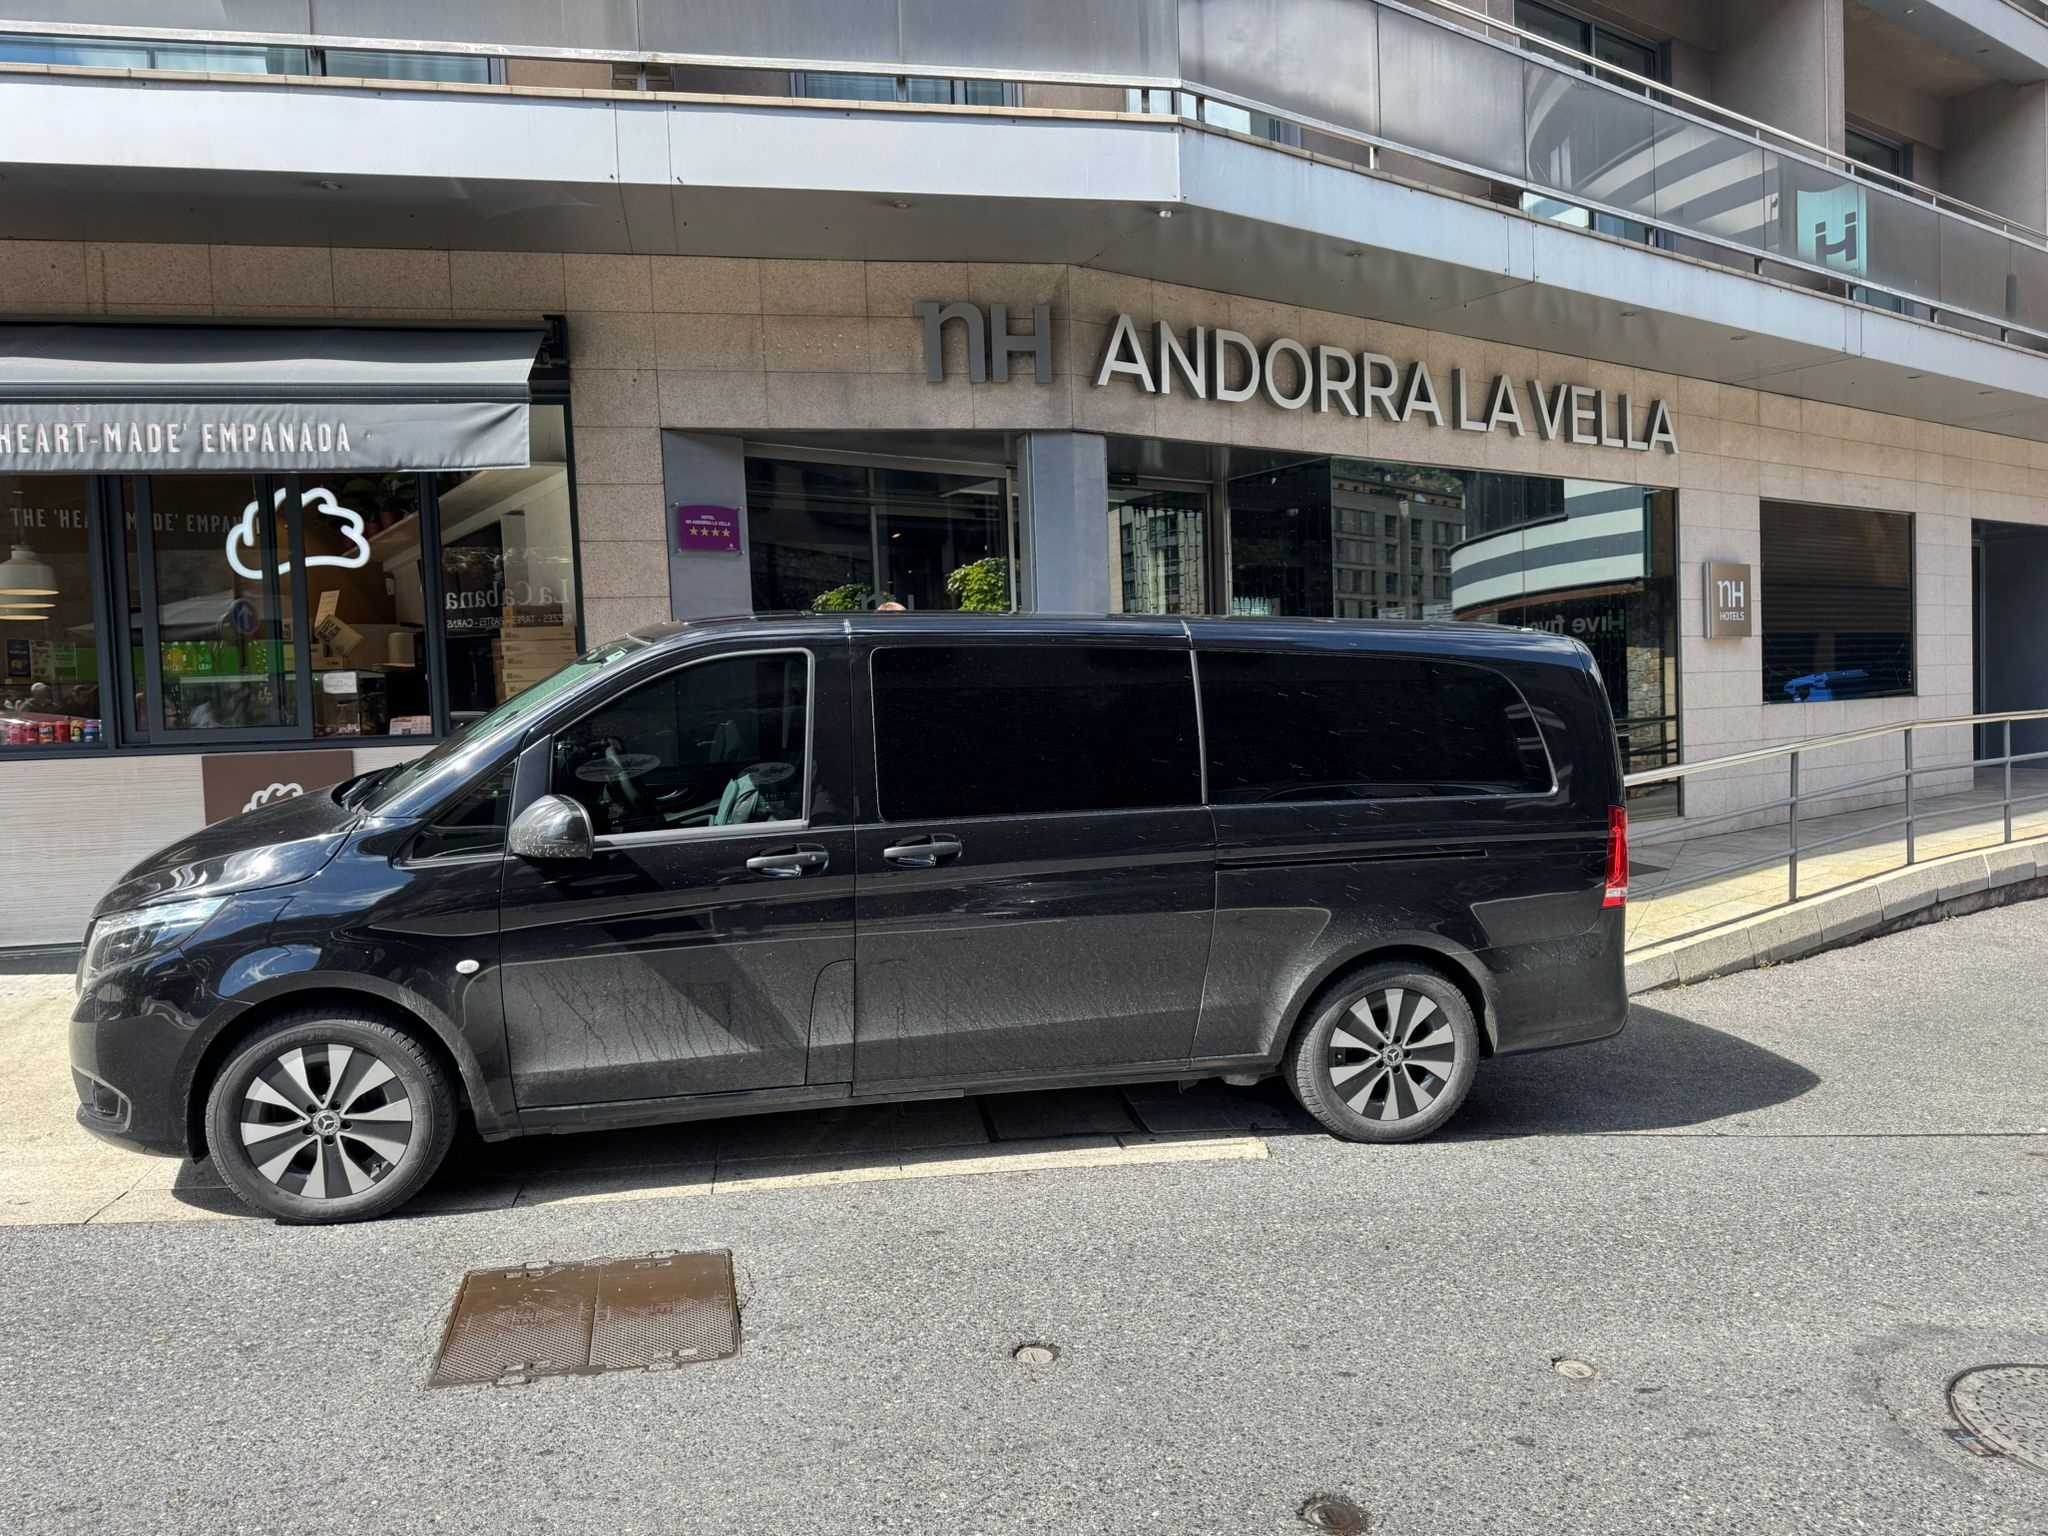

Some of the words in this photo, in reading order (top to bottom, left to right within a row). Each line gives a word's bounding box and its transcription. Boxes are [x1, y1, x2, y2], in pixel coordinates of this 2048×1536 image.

[1096, 314, 1444, 426] ANDORRA
[1452, 367, 1525, 436] LA
[1526, 379, 1679, 454] VELLA
[202, 422, 351, 453] EMPANADA
[10, 507, 46, 527] THE
[1720, 611, 1745, 621] HOTELS
